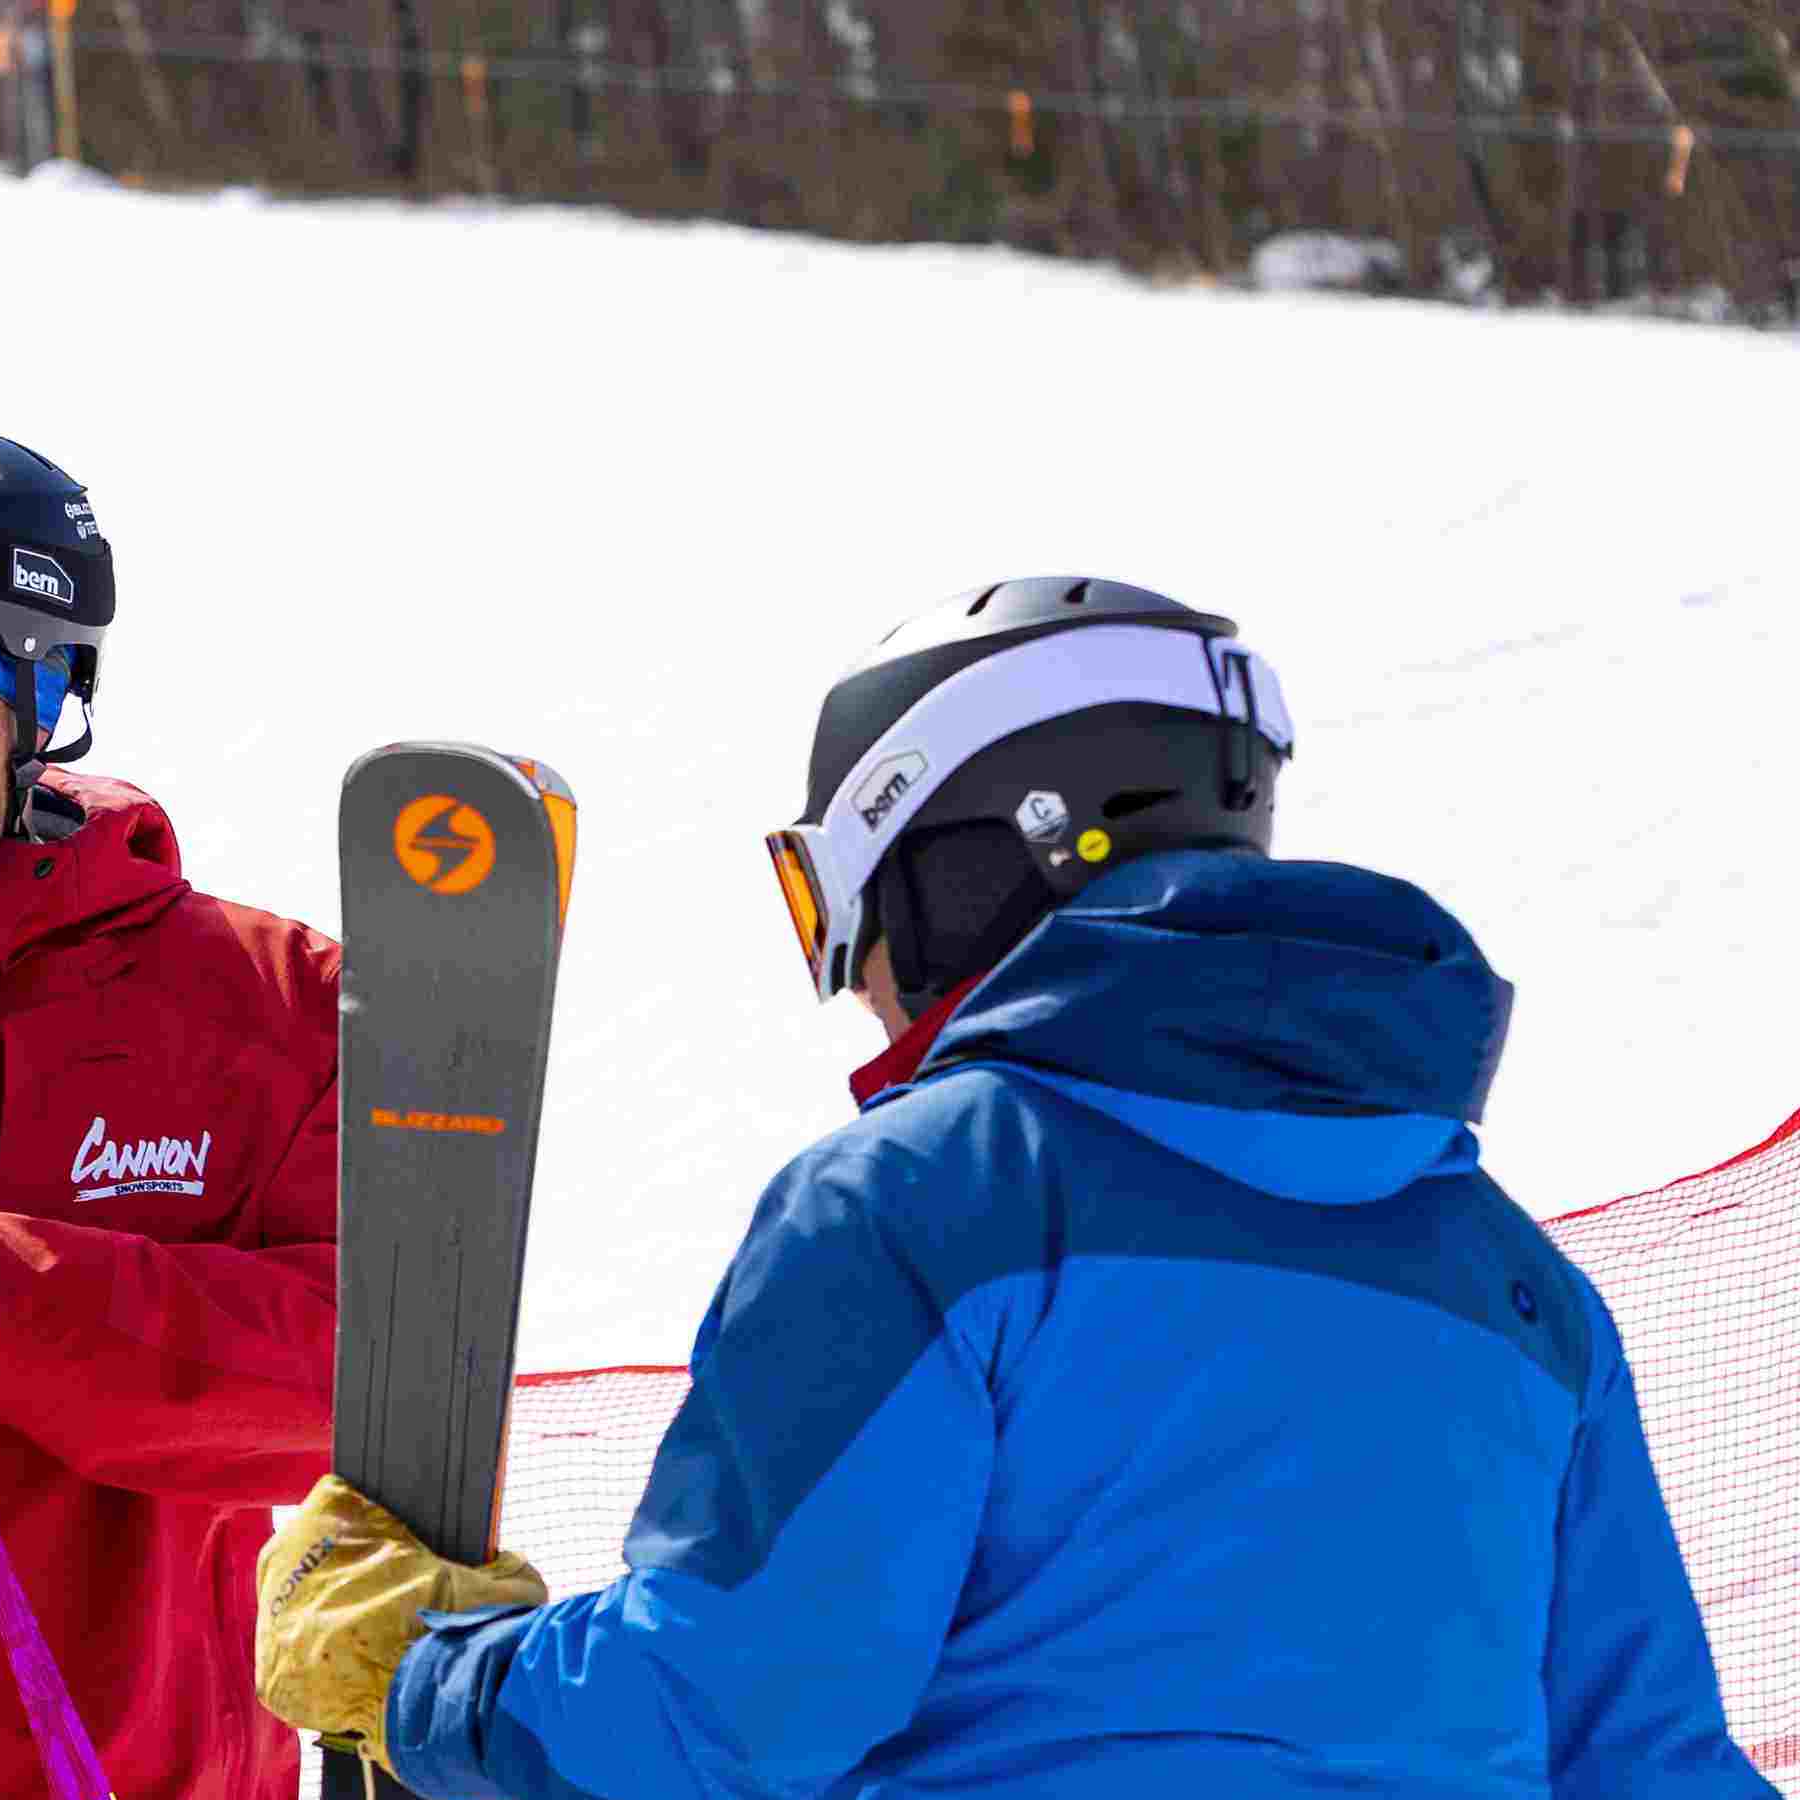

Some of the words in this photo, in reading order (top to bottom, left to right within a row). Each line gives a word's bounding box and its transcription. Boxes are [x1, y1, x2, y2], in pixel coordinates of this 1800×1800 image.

[16, 564, 58, 595] bern
[861, 772, 910, 833] bern
[114, 1181, 185, 1195] SNOWSPORTS
[271, 1535, 335, 1617] KINCO
